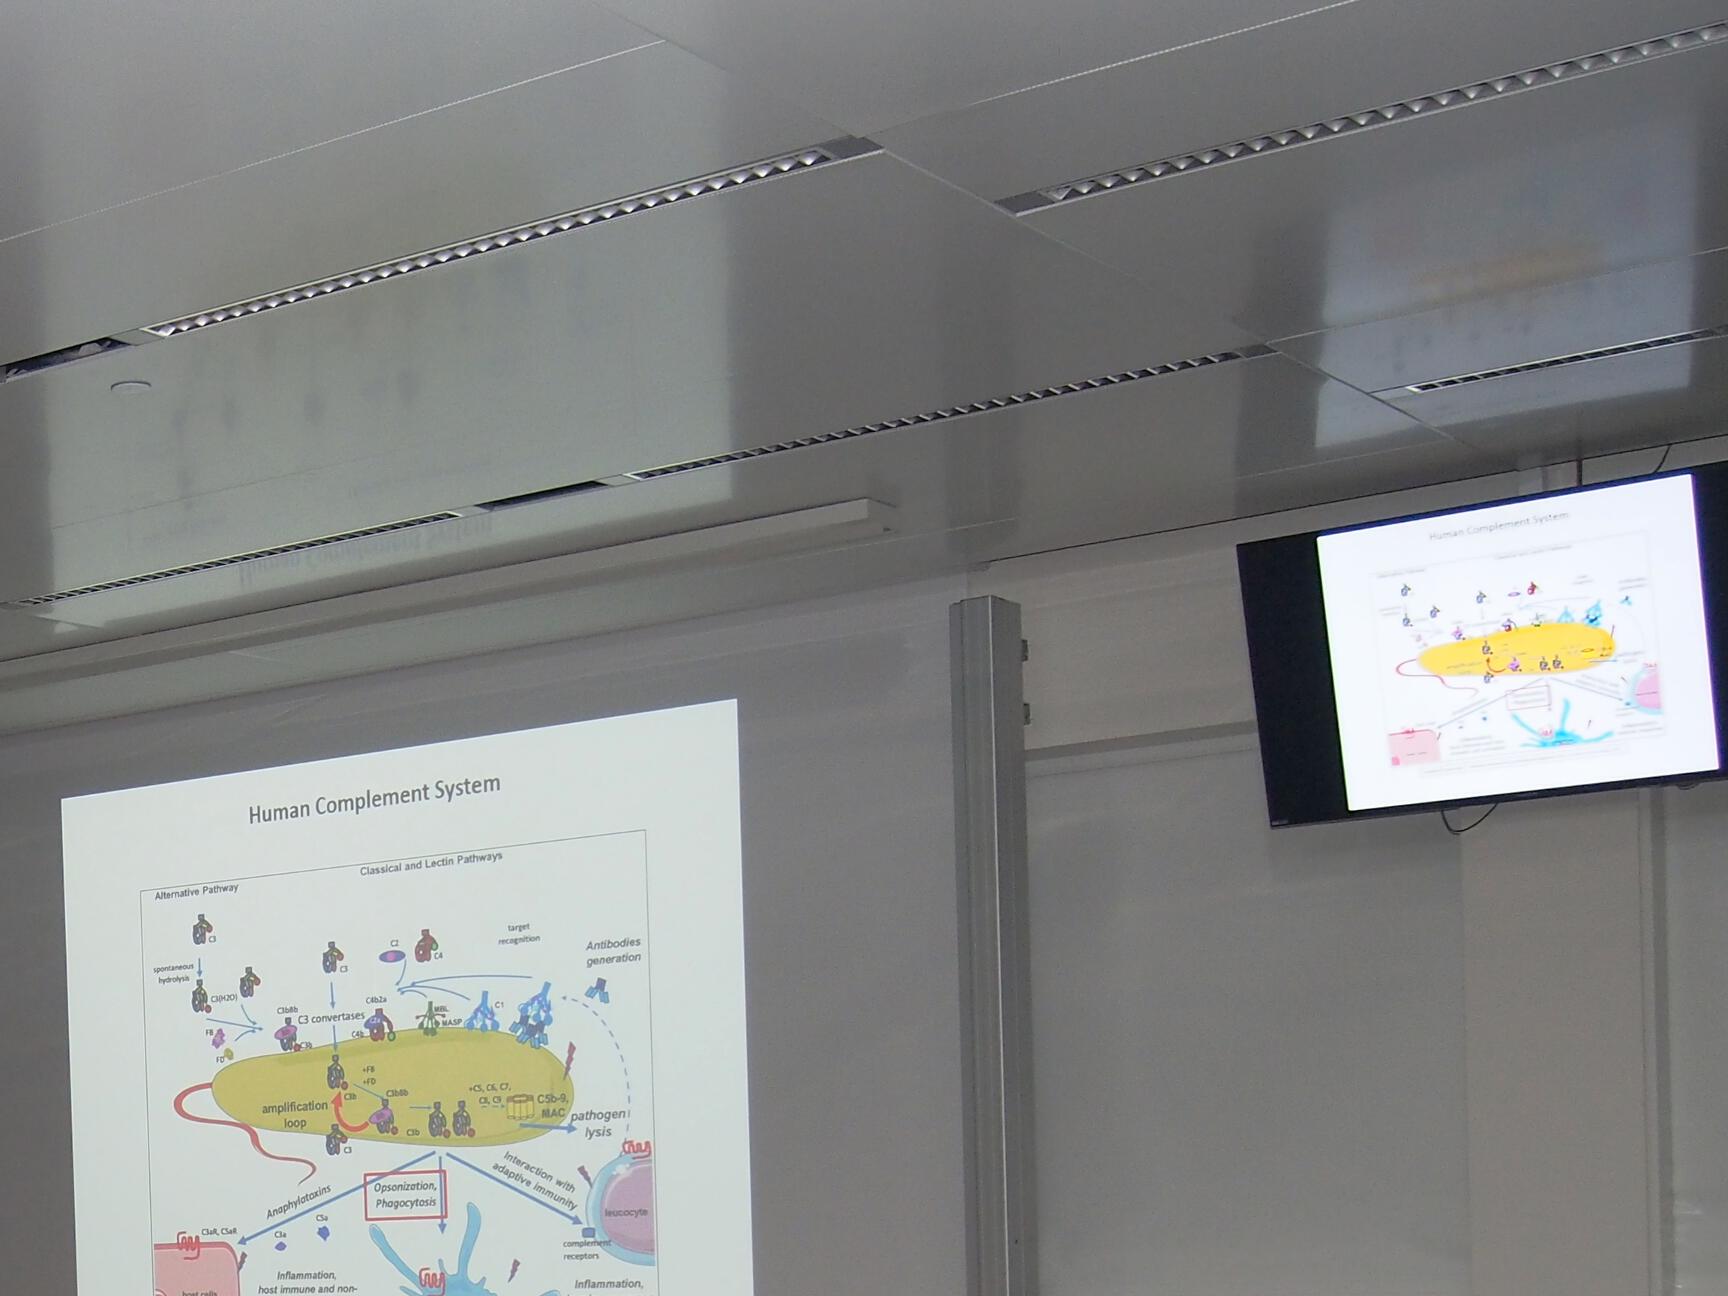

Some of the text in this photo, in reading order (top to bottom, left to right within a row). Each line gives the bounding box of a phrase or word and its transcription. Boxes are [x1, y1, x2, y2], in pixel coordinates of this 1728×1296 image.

[249, 777, 501, 824] Human Complement System
[360, 851, 503, 876] Classical and Lectin Pathways
[155, 883, 239, 900] Alternative Pathway
[508, 923, 530, 932] target
[498, 934, 541, 946] recognition
[585, 938, 641, 951] Antibodies
[587, 952, 641, 968] generation
[153, 962, 194, 974] spontaneous
[158, 975, 190, 985] hydrolysis
[298, 1011, 365, 1024] C3 convertases
[262, 1101, 328, 1115] amplification
[541, 1109, 566, 1118] MAC
[571, 1109, 626, 1123] pathogen
[284, 1119, 307, 1129] loop
[585, 1127, 612, 1140] lysis
[503, 1151, 575, 1193] Interaction with
[374, 1181, 437, 1193] Opsonization,
[492, 1162, 578, 1211] adaptive immunity
[266, 1184, 332, 1220] Anaphylatoxins
[376, 1197, 437, 1210] Phagocytosis
[604, 1208, 648, 1218] leucocyte
[563, 1239, 612, 1248] complement
[563, 1252, 599, 1261] receptors
[277, 1270, 337, 1281] Inflammation,
[258, 1285, 358, 1294] host immune and non-
[574, 1279, 644, 1290] Inflammation,
